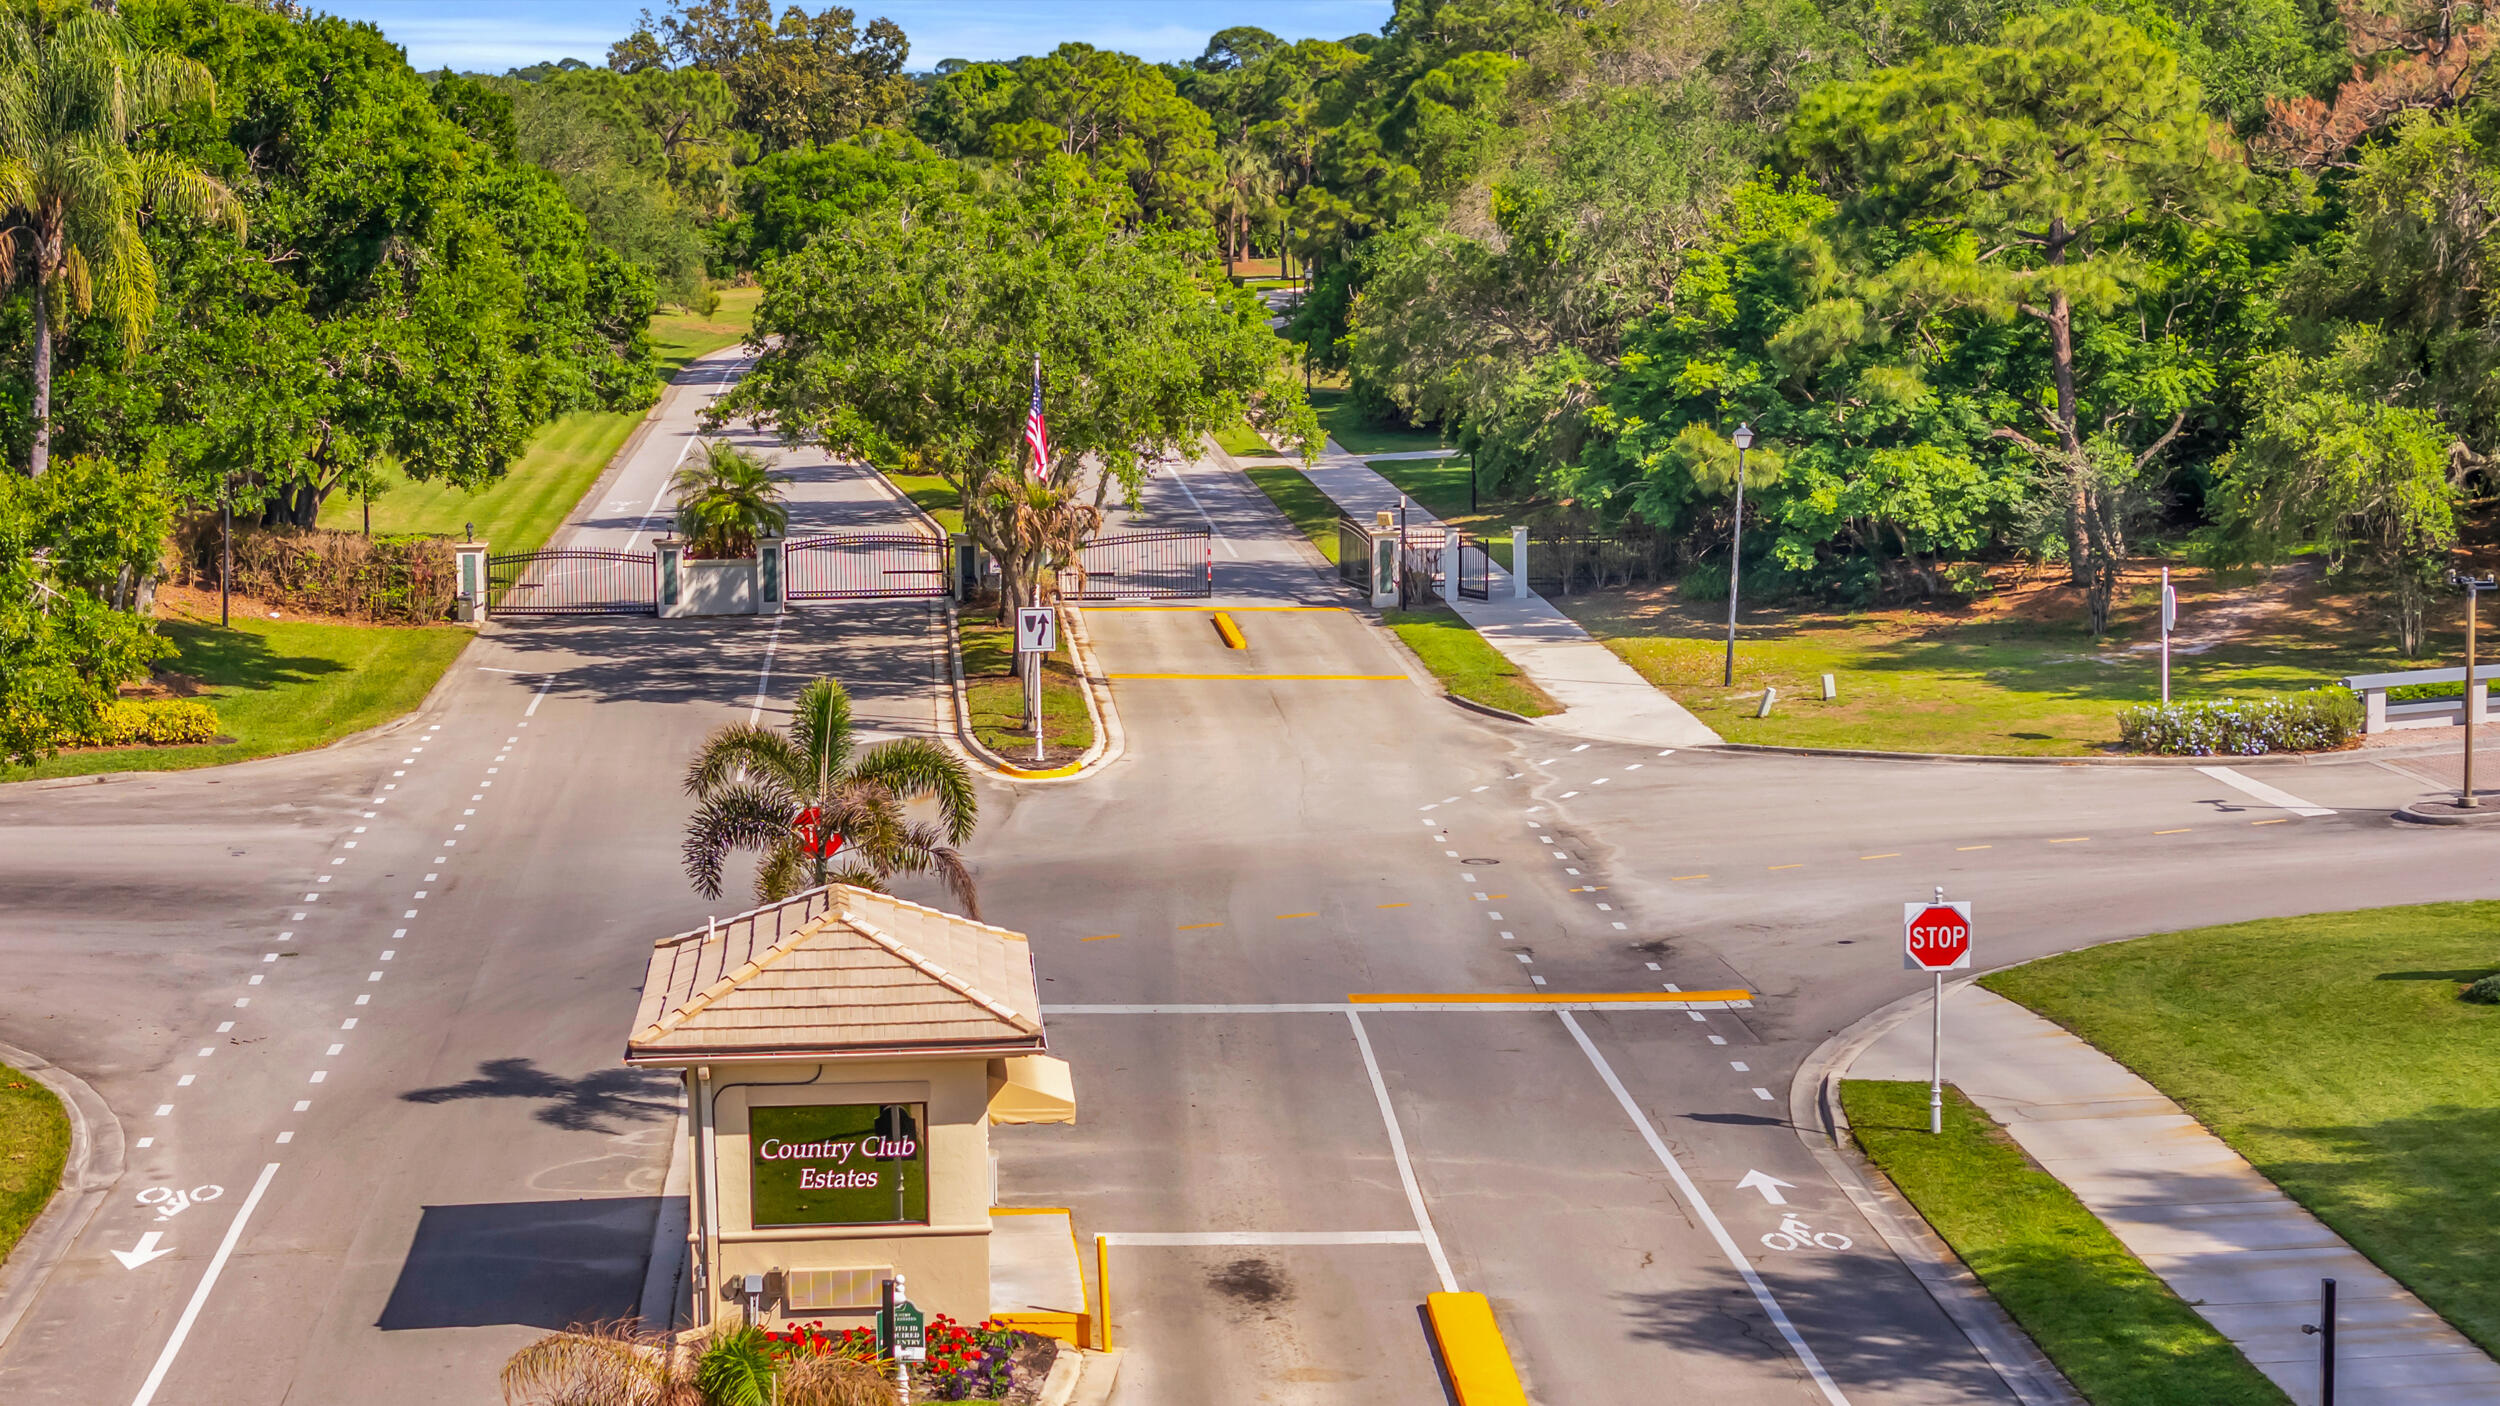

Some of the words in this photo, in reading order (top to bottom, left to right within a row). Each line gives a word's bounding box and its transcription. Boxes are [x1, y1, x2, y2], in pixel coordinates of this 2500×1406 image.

[1912, 926, 1966, 949] STOP
[760, 1138, 856, 1164] Country
[861, 1135, 917, 1157] Club
[800, 1167, 879, 1189] Estates
